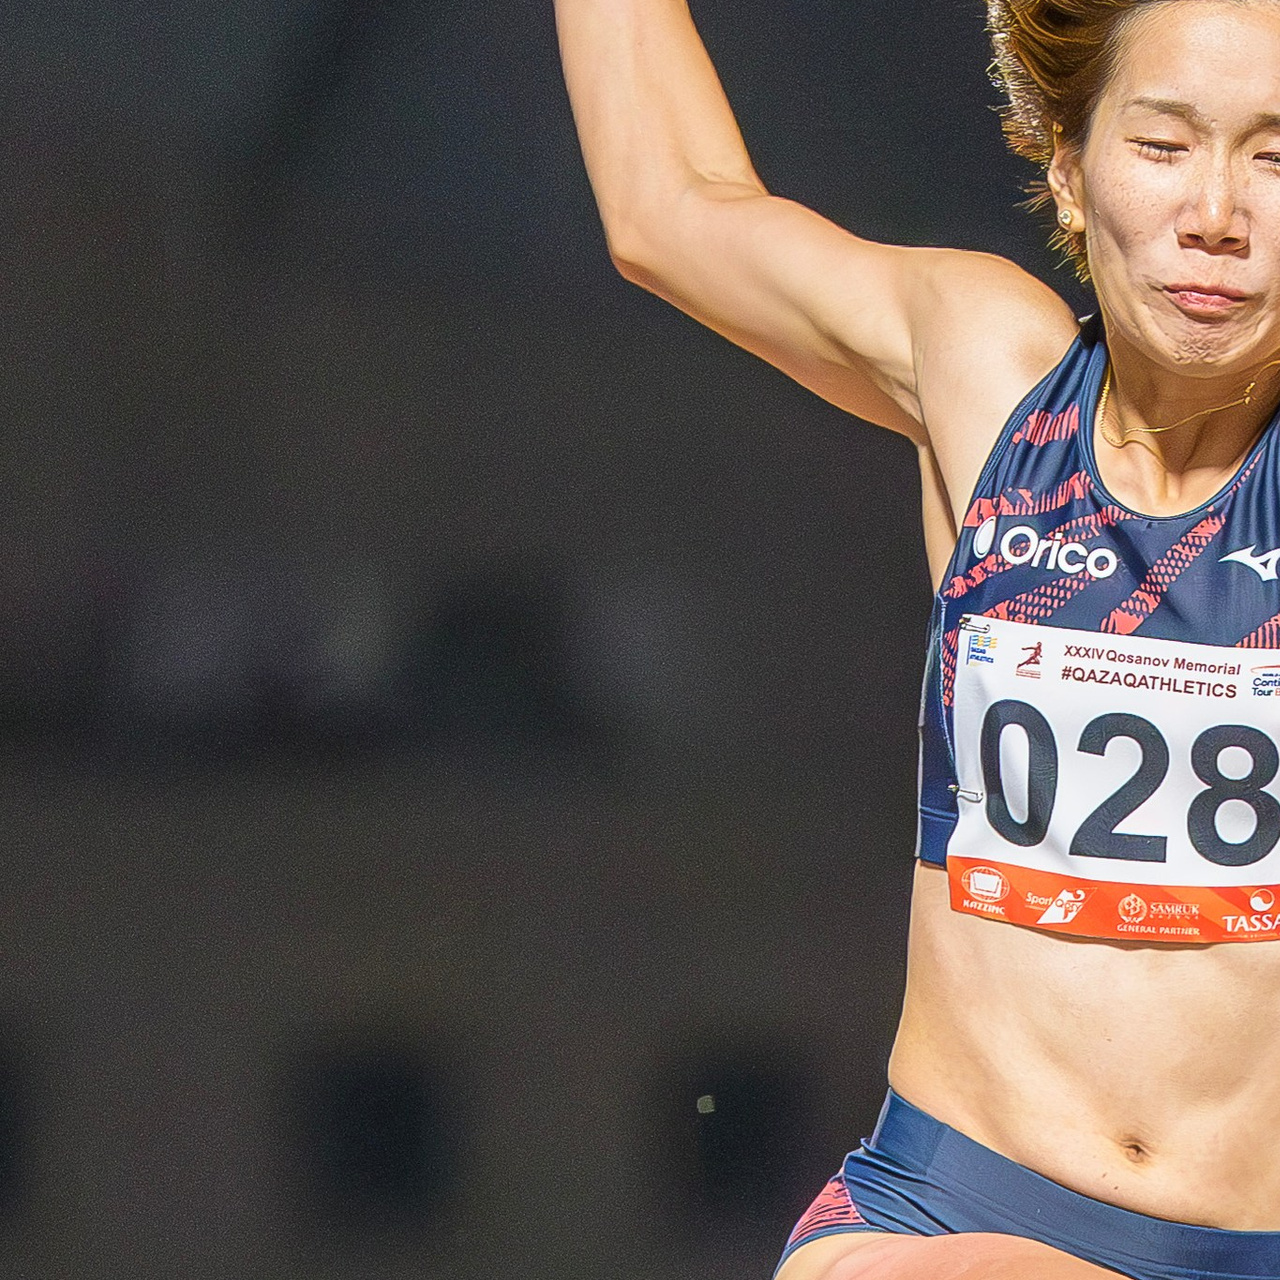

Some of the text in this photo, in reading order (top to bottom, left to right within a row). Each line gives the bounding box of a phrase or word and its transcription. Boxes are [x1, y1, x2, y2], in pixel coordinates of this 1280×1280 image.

[1000, 525, 1117, 578] Orico
[1064, 645, 1241, 675] XXXIV Qosanov Memorial
[1061, 666, 1238, 699] #QAZAQATHLETICS
[1252, 687, 1273, 696] Tour
[1025, 892, 1053, 906] Sport
[1117, 923, 1200, 936] GENERAL PARTNER
